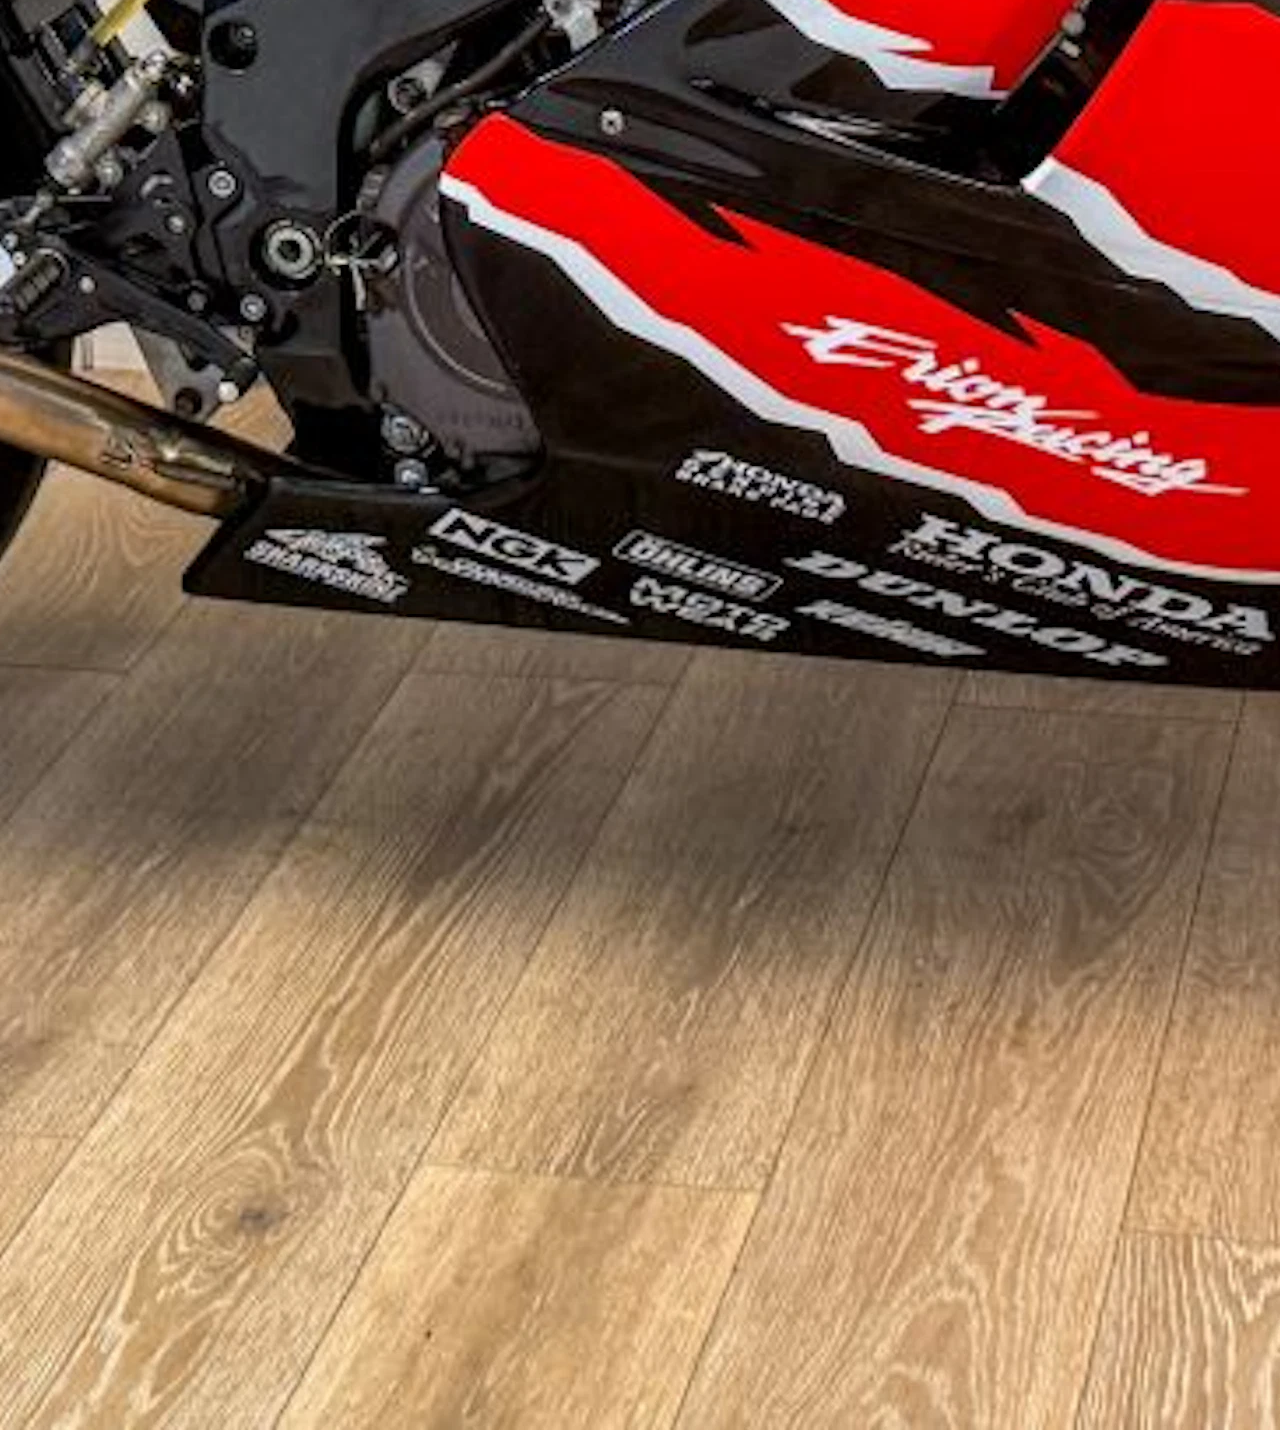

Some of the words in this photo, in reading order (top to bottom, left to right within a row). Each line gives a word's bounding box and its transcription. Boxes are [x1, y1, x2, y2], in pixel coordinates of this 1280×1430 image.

[780, 315, 1098, 418] Erion
[906, 398, 1250, 498] Racing
[434, 511, 592, 581] NGK
[910, 512, 1276, 642] HONDA
[782, 550, 1169, 667] DUNLOP
